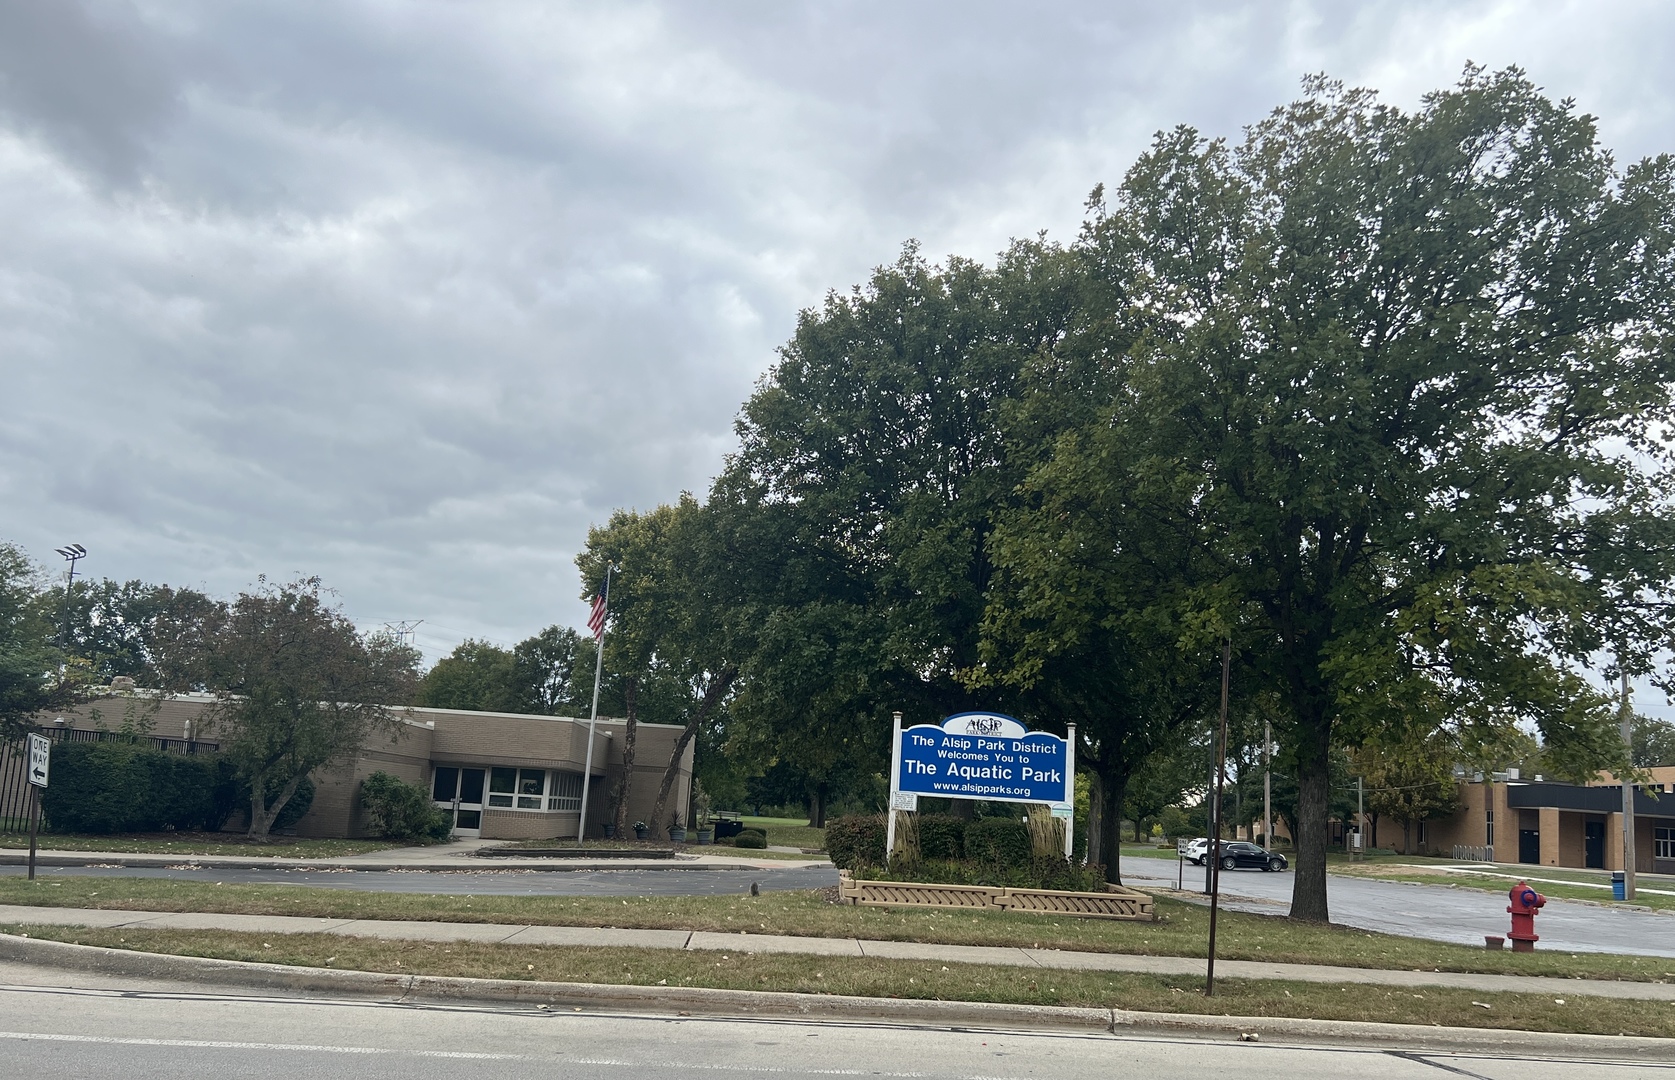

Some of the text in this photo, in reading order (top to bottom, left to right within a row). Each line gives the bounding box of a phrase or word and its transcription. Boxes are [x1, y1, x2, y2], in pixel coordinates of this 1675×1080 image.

[33, 738, 47, 753] ONE
[911, 735, 1057, 754] The Alsip Park District
[32, 751, 47, 766] WAY
[937, 749, 1030, 764] Welcomes You to
[904, 759, 1061, 783] The Aquatic Park
[933, 782, 1031, 797] www.alsipparks.org
